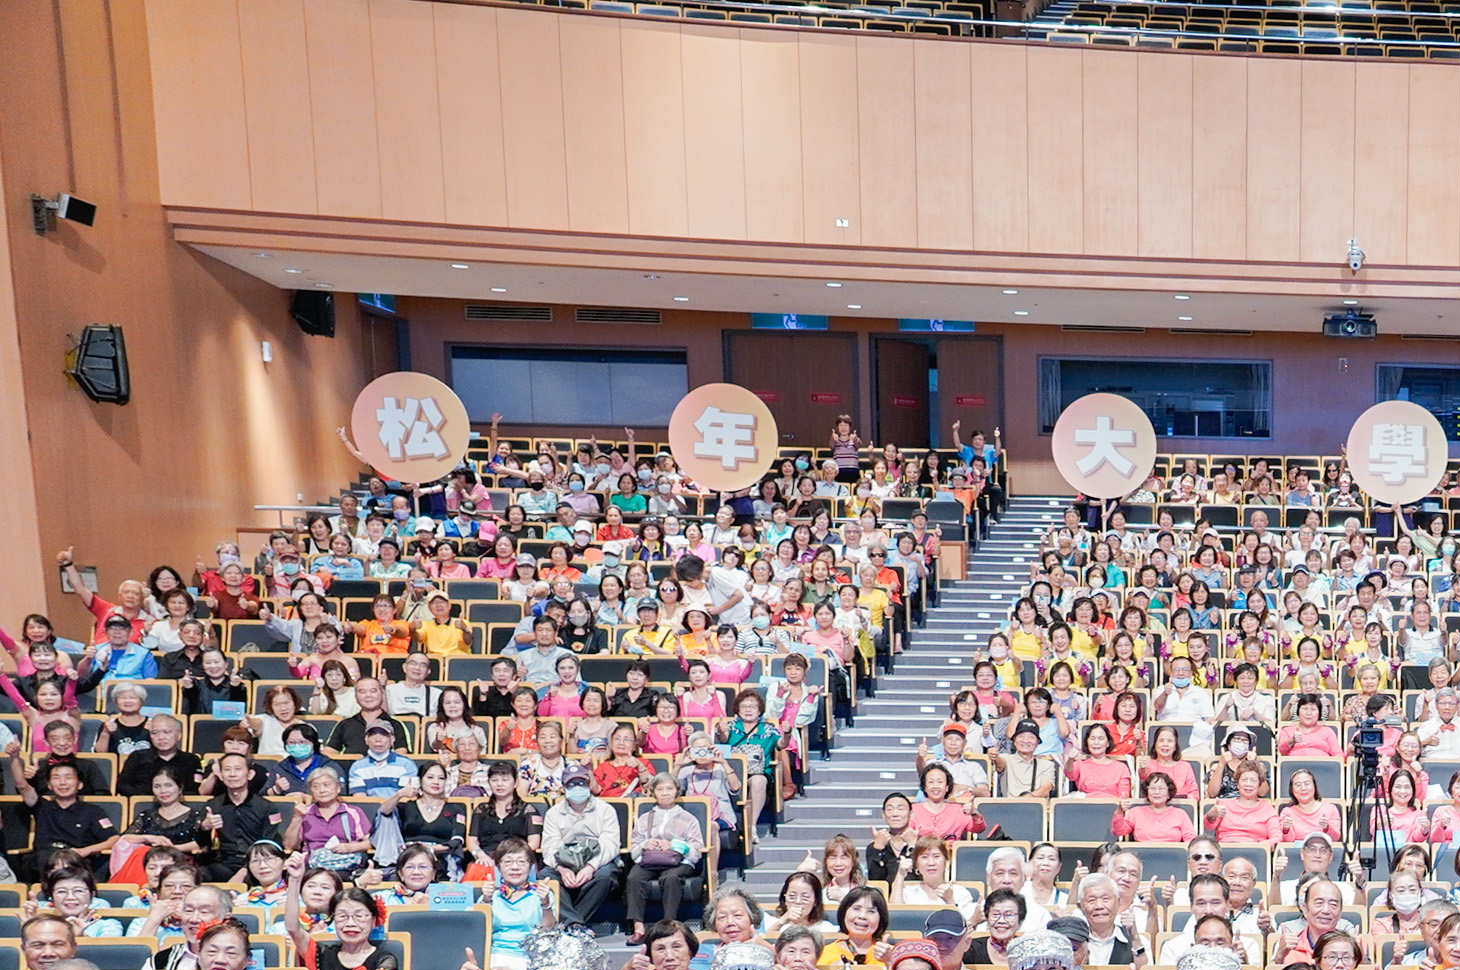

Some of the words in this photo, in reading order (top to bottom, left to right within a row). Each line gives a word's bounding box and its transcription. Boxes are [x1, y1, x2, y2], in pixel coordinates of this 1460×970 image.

[377, 396, 446, 462] 松
[694, 405, 758, 470] 年
[1075, 416, 1135, 478] 大
[1368, 421, 1430, 485] 學
